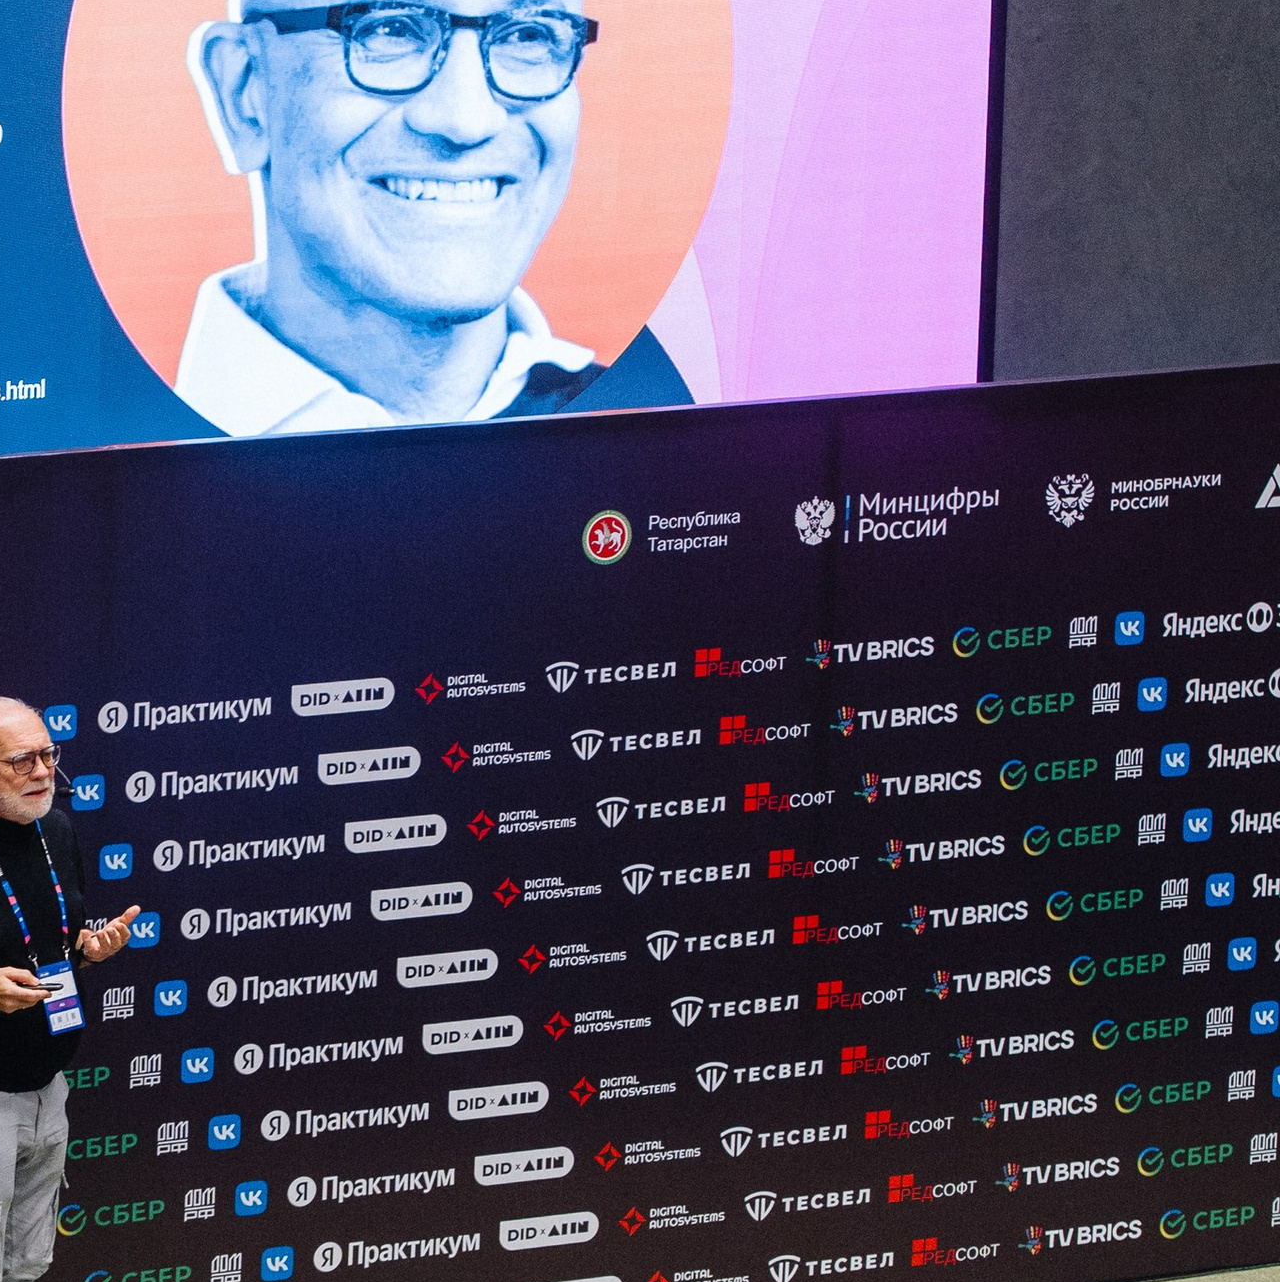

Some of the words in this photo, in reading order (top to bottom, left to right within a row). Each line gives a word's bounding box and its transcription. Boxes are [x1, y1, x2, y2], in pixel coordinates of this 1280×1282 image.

[1111, 473, 1222, 494] МИНОБРНАУКИ
[859, 486, 1000, 517] Минцифры
[1110, 494, 1169, 512] РОССИИ
[648, 510, 741, 532] Республика
[858, 517, 947, 543] России
[647, 534, 728, 553] Татарстан
[987, 625, 1052, 650] СБЕР
[1119, 620, 1140, 637] VK
[1162, 612, 1243, 639] Яндекс
[833, 642, 864, 663] TV
[866, 636, 935, 661] BRICS
[584, 661, 677, 685] ТЕСВЕЛ
[707, 656, 787, 676] РЕДСОФТ
[446, 681, 526, 699] AUTOSYSTEMS
[447, 673, 488, 687] DIGITAL
[1184, 678, 1265, 704] Яндекс
[299, 692, 331, 708] DID
[1010, 692, 1075, 716] СБЕР
[133, 696, 272, 731] Практикум
[857, 709, 888, 730] TV
[890, 702, 958, 728] BRICS
[609, 729, 701, 752] ТЕСВЕЛ
[732, 723, 812, 745] РЕДСОФТ
[472, 749, 552, 767] AUTOSYSTEMS
[473, 741, 514, 755] DIGITAL
[161, 765, 299, 800] Практикум
[188, 834, 326, 869] Практикум
[1080, 888, 1144, 913] СБЕР
[929, 907, 959, 929] TV
[961, 900, 1029, 926] BRICS
[684, 928, 775, 953] ТЕСВЕЛ
[159, 989, 182, 1007] VK
[242, 969, 378, 1005] Практикум
[828, 986, 908, 1010] РЕДСОФТ
[599, 1075, 640, 1089] DIGITAL
[599, 1082, 677, 1100] AUTOSYSTEMS
[295, 1102, 430, 1138] Практикум
[1022, 1164, 1052, 1186] TV
[1054, 1156, 1120, 1182] BRICS
[94, 1199, 165, 1226] СБЕР
[805, 1251, 894, 1277] ТЕСВЕЛ
